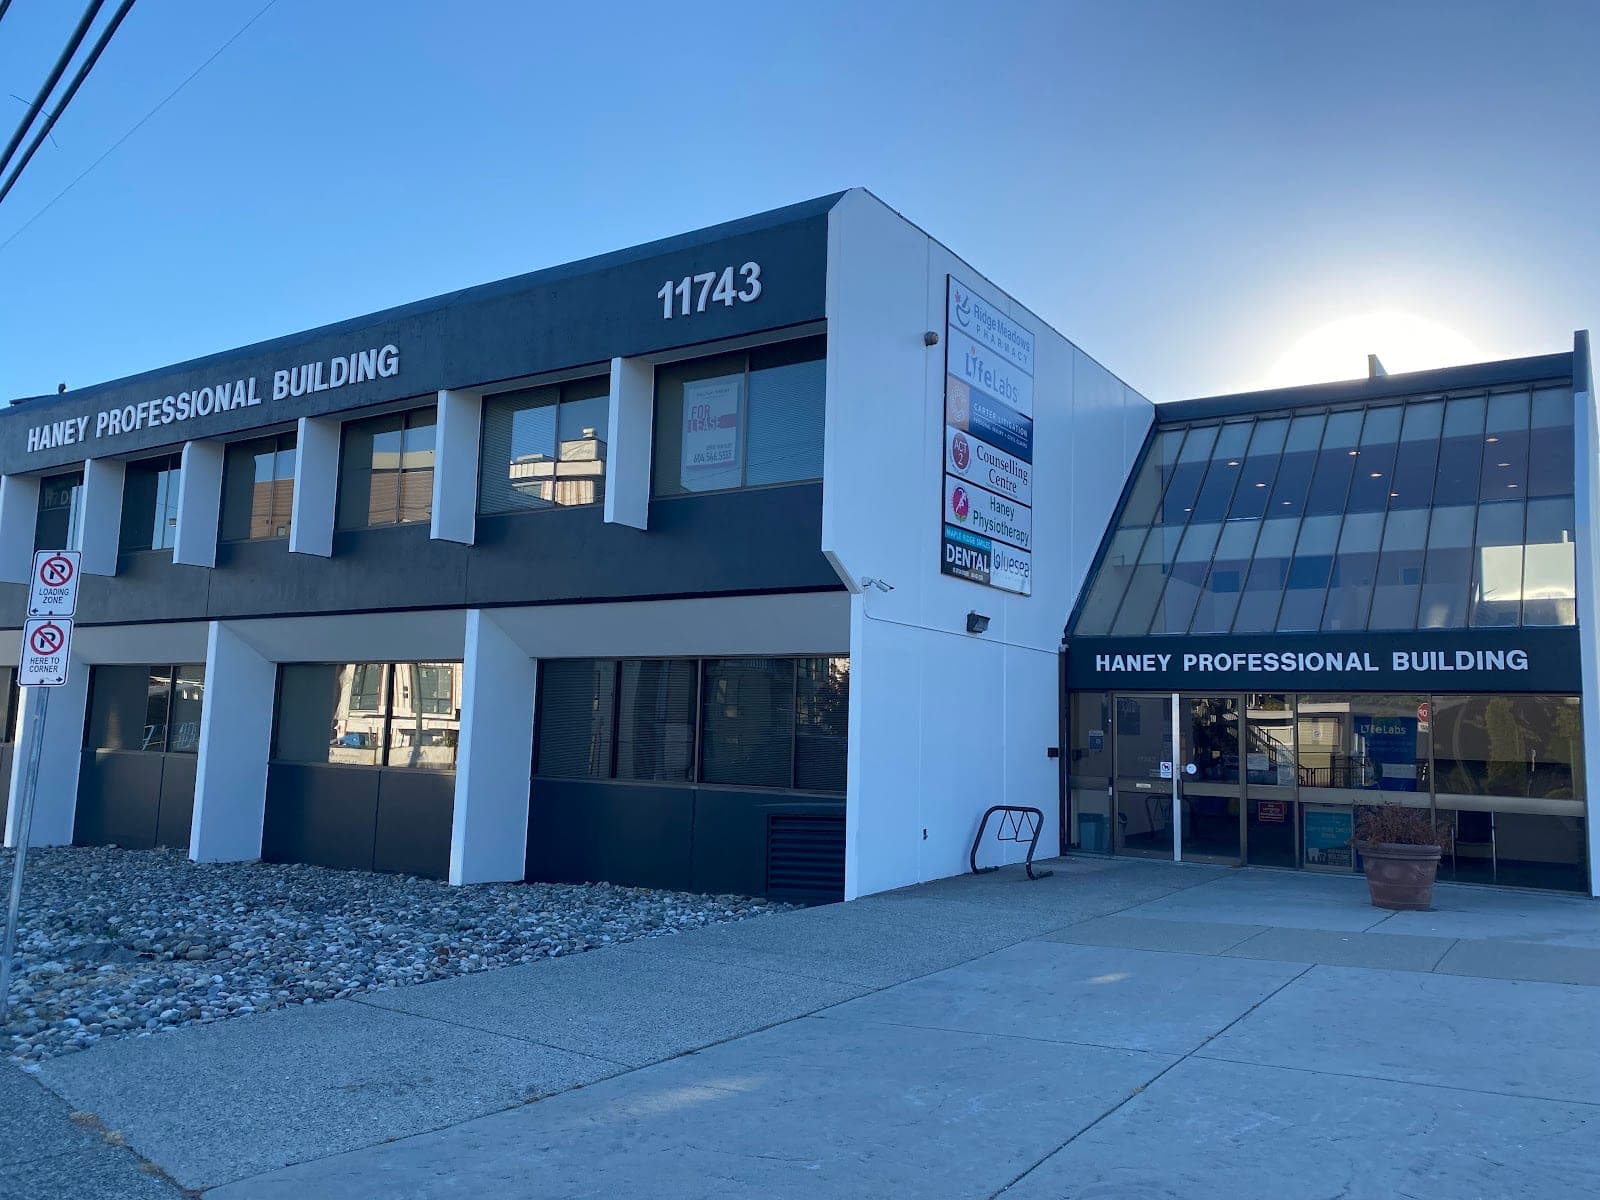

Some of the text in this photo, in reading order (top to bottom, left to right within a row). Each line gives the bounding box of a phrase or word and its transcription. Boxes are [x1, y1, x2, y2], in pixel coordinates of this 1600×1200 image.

[657, 261, 762, 319] 11743
[973, 304, 997, 331] Ridge
[976, 324, 1028, 364] PHARMACY
[27, 344, 400, 453] HANEY PROFESSIONAL BUILDING
[691, 404, 710, 420] FOR
[954, 439, 968, 452] ACT
[957, 454, 964, 466] 2
[976, 444, 1028, 485] Counselling
[988, 468, 1017, 494] Centre
[989, 496, 1015, 519] Haney
[972, 510, 1030, 546] Physiotherapy
[946, 543, 989, 573] DENTAL
[39, 588, 69, 596] LOADING
[42, 596, 63, 604] ZONE
[29, 665, 58, 673] CORNER
[30, 657, 48, 665] HERE
[1096, 649, 1529, 672] HANEY PROFESSIONAL BUILDING
